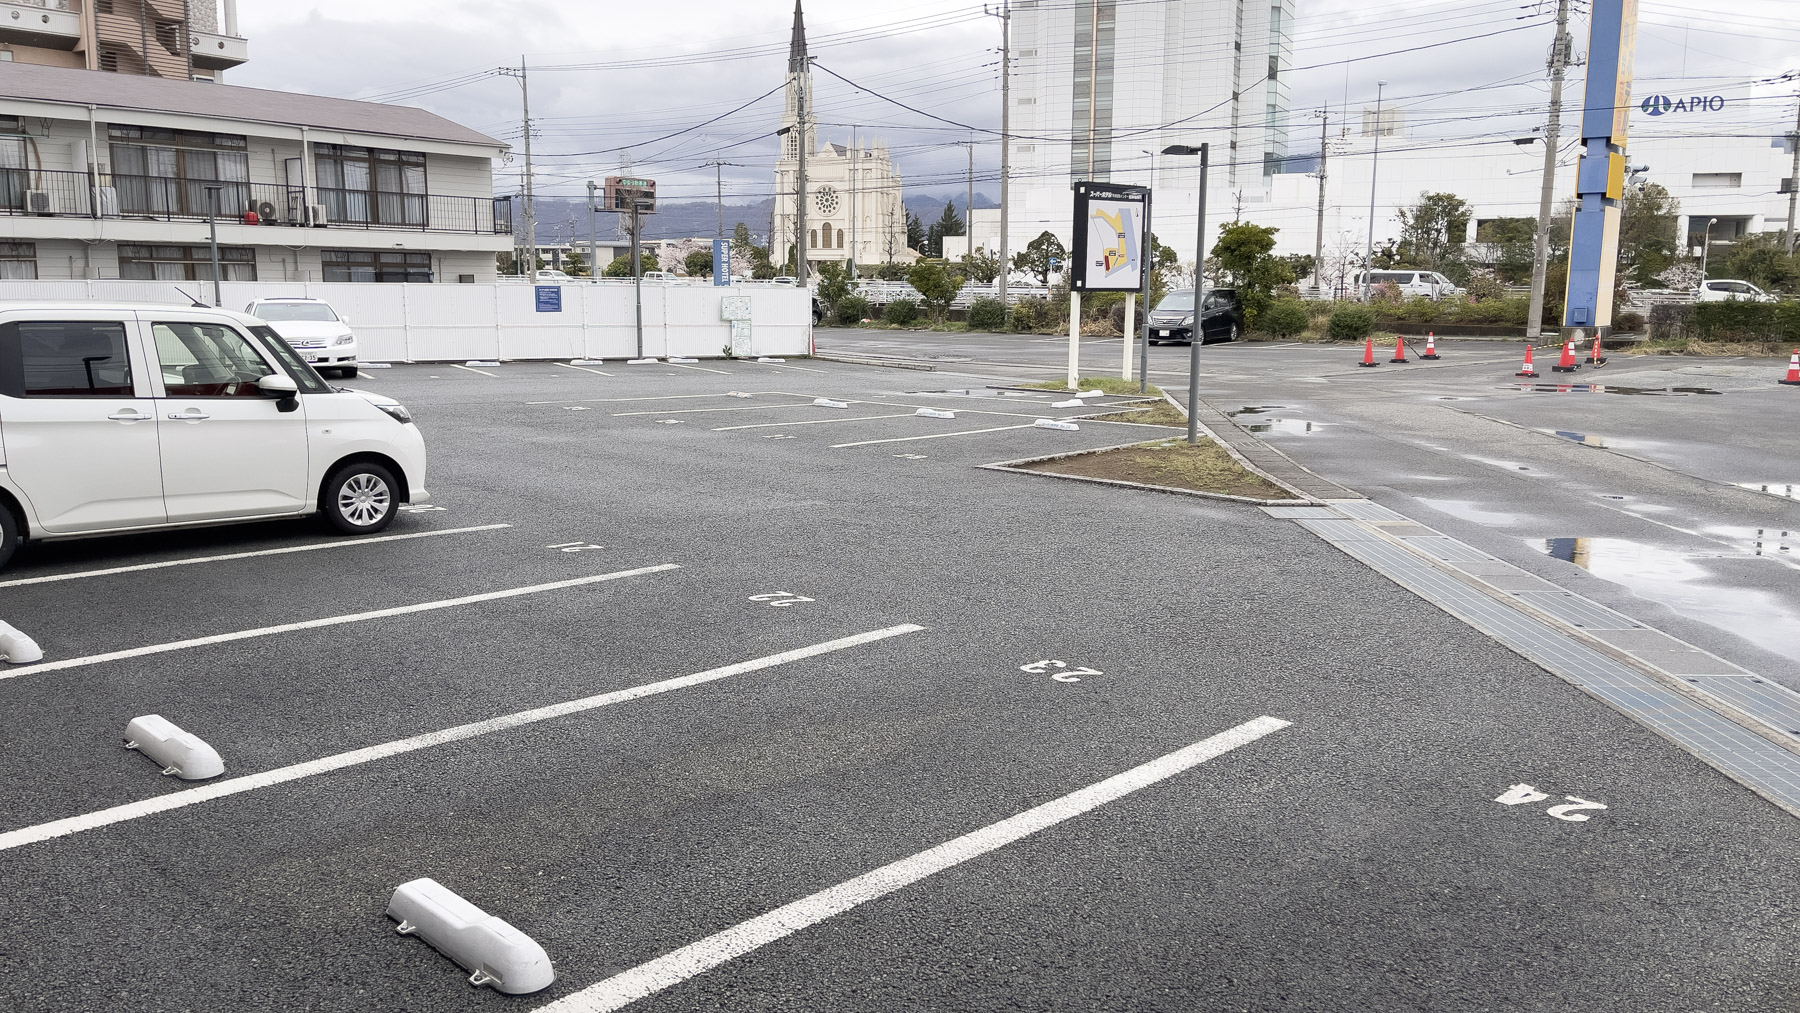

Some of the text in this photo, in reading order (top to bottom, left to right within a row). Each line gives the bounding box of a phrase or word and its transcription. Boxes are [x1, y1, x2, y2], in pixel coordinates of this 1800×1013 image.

[1672, 96, 1724, 112] APIO
[720, 242, 730, 283] SUPER HOTEL
[546, 541, 604, 552] 21
[748, 590, 816, 606] 22
[1020, 660, 1104, 682] 23
[1494, 783, 1608, 821] 24
